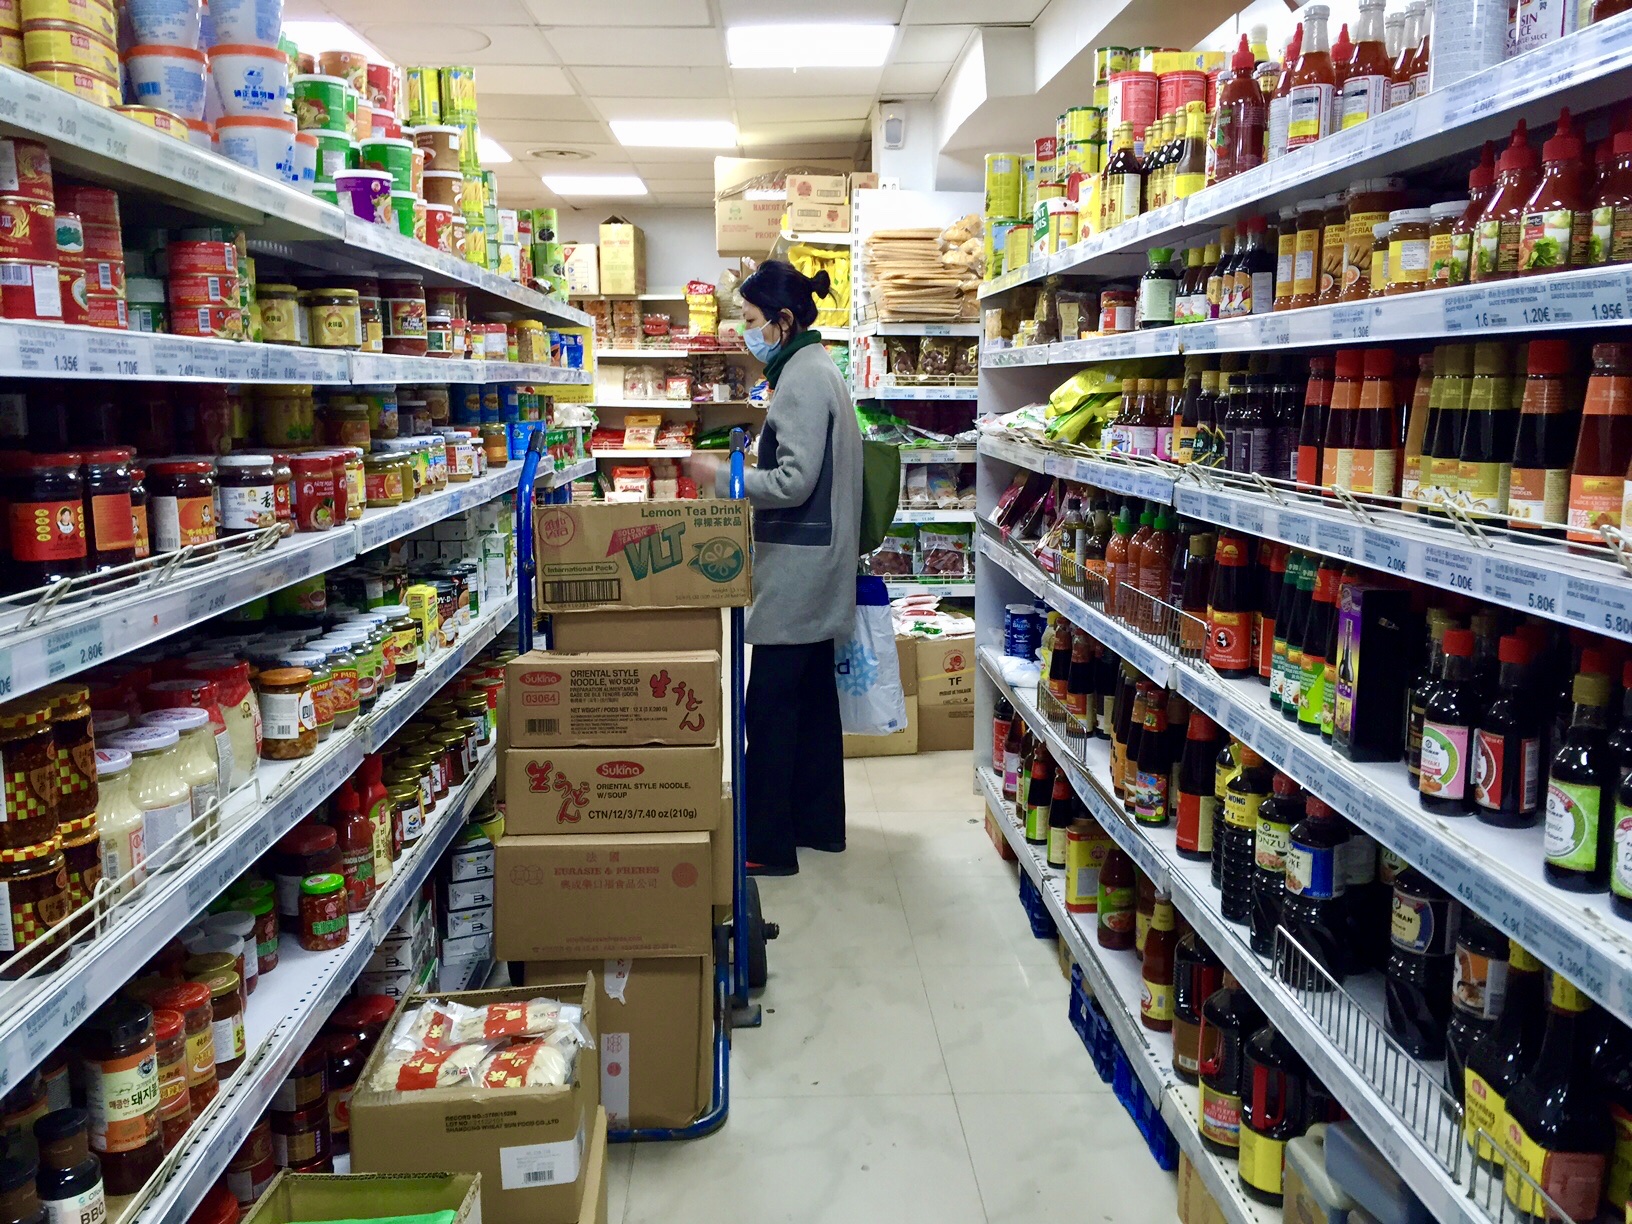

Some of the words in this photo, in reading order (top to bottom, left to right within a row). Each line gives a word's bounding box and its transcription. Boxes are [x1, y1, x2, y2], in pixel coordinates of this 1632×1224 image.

[1522, 307, 1551, 323] 1.20€
[1591, 302, 1624, 320] 1.95€
[54, 355, 78, 372] 1.35€
[117, 360, 138, 375] 1.70€
[641, 508, 681, 519] Lemon
[685, 506, 706, 517] Tea
[710, 504, 742, 516] Drink
[694, 516, 742, 528] 檸檬茶飲品
[623, 521, 686, 582] VLT
[595, 564, 613, 572] Pack
[1387, 555, 1406, 573] 2.00€
[1450, 572, 1473, 591] 2.00€
[1528, 592, 1555, 613] 5.80€
[80, 642, 103, 664] 2.80€
[524, 673, 557, 684] Sukina
[570, 669, 610, 678] ORIENTAL
[612, 669, 639, 677] STYLE
[948, 676, 962, 686] TF
[570, 678, 607, 687] NOODLE,
[601, 764, 641, 776] Sukina
[597, 791, 628, 799] W/SOUP
[588, 809, 656, 820] CTN/12/3/7.40
[554, 867, 601, 876] EURASIE
[604, 867, 612, 875] &
[63, 996, 88, 1027] 4.20€
[80, 1201, 105, 1224] BBQ
